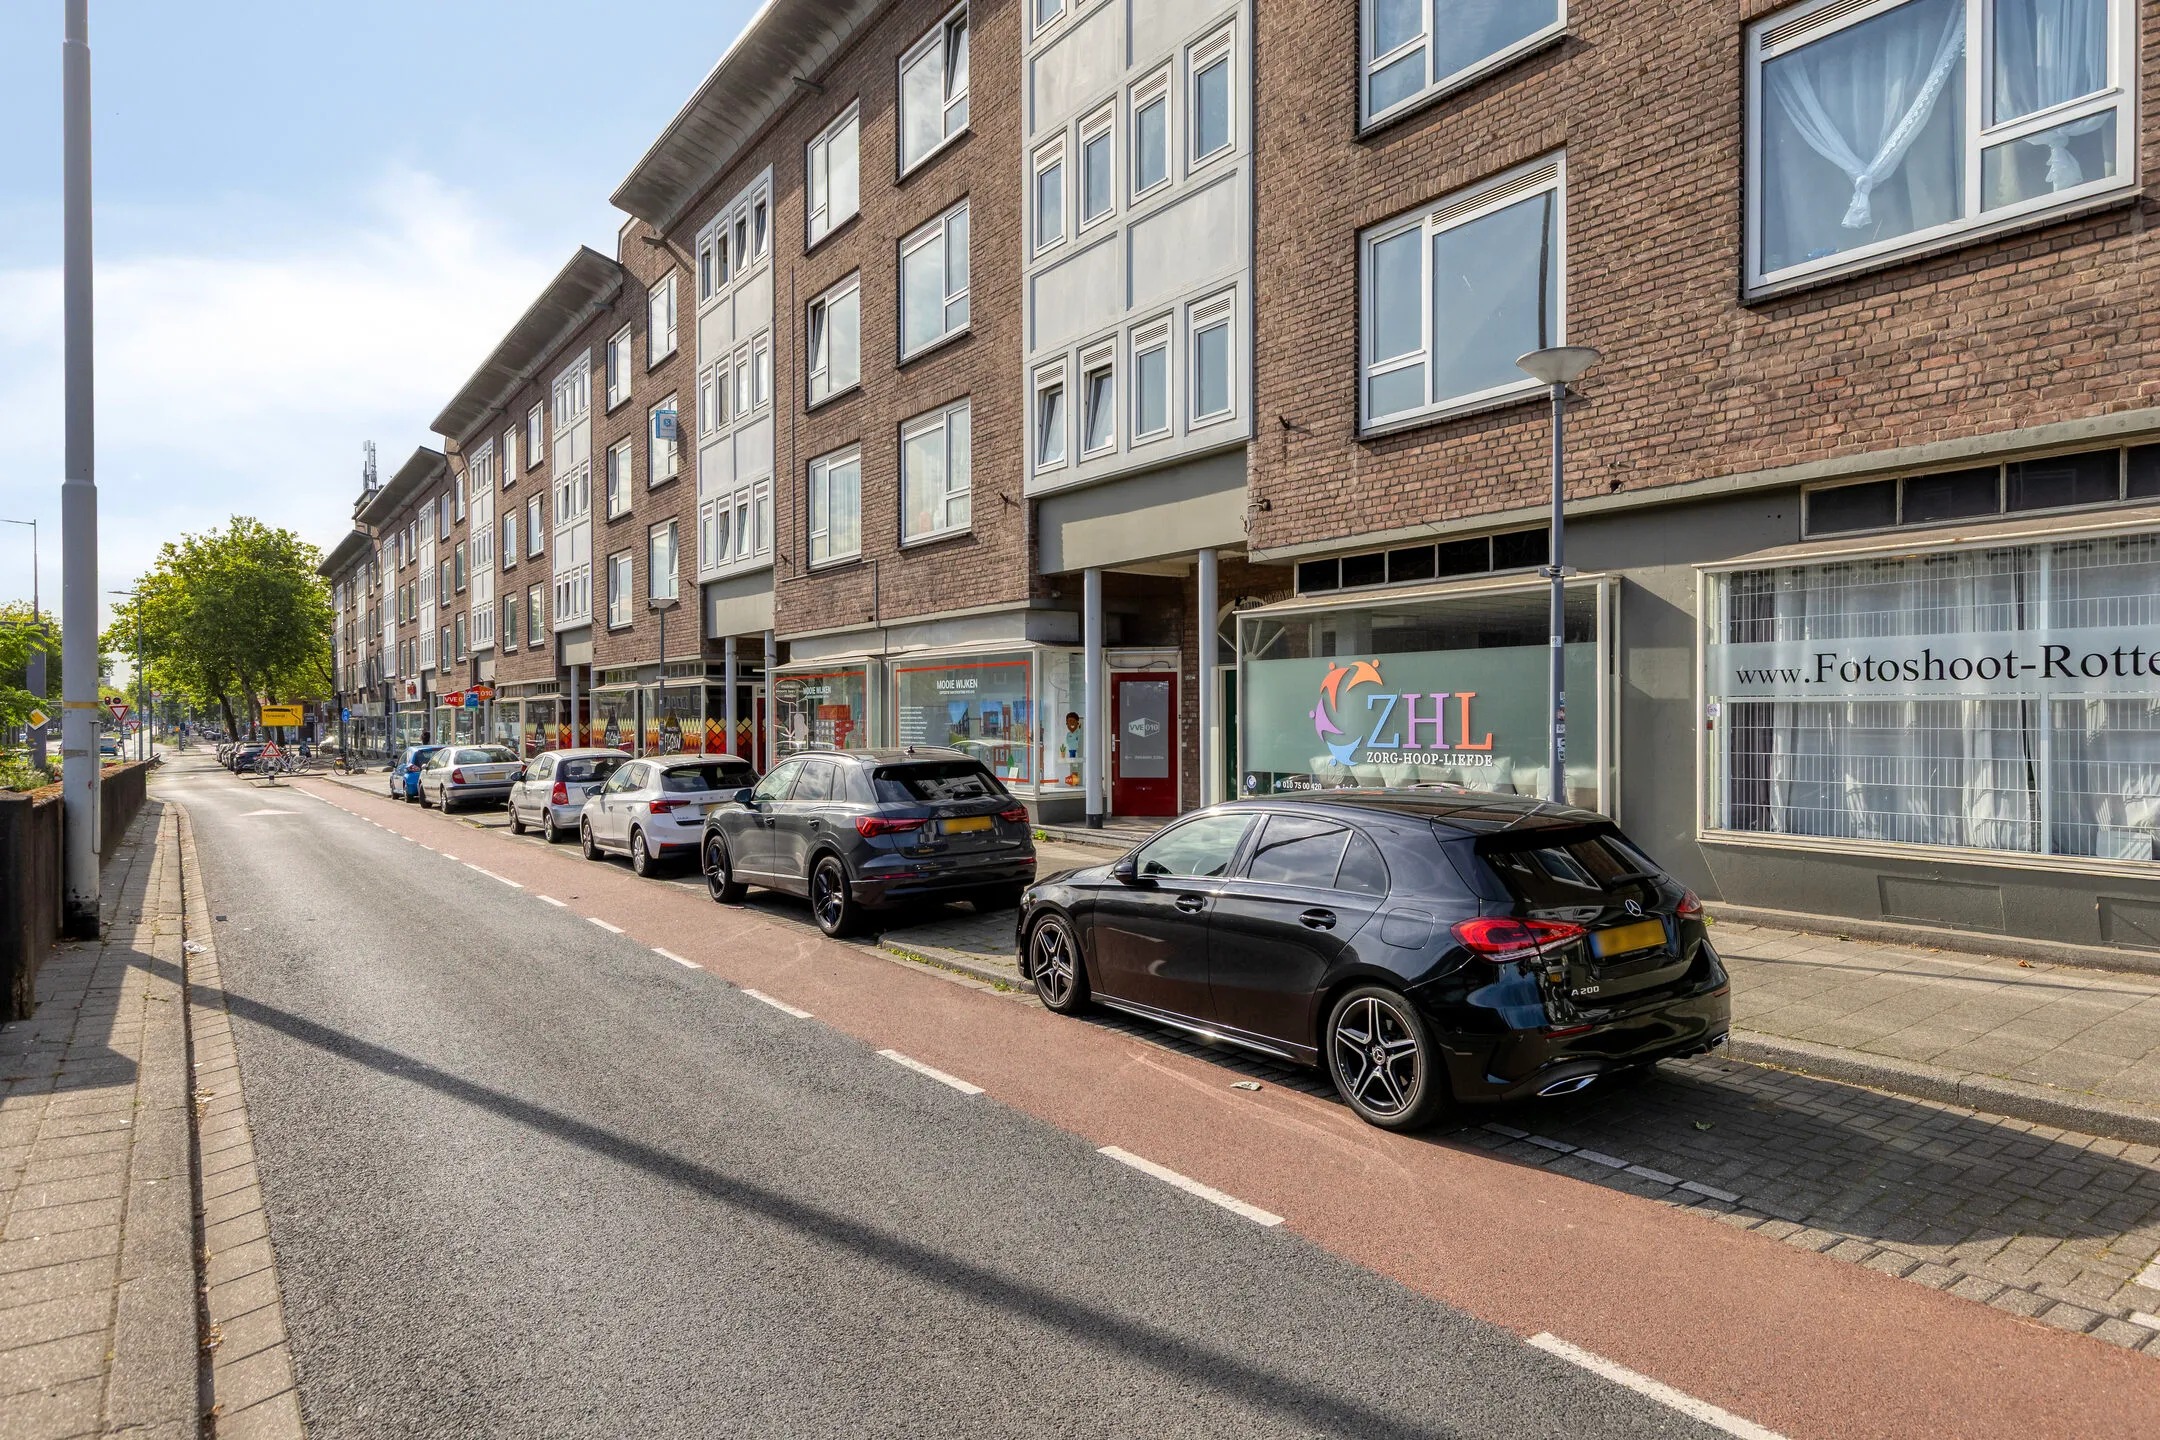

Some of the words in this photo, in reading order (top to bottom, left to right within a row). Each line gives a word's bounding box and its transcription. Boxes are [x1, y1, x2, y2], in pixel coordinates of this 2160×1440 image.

[936, 680, 955, 689] MOOIE
[1367, 692, 1493, 750] ZHL
[1366, 751, 1493, 767] ZORG-HOOP-LIEFDE
[1282, 780, 1293, 789] 010
[1294, 781, 1301, 790] 75
[1302, 782, 1310, 790] 00
[1580, 986, 1600, 995] 200
